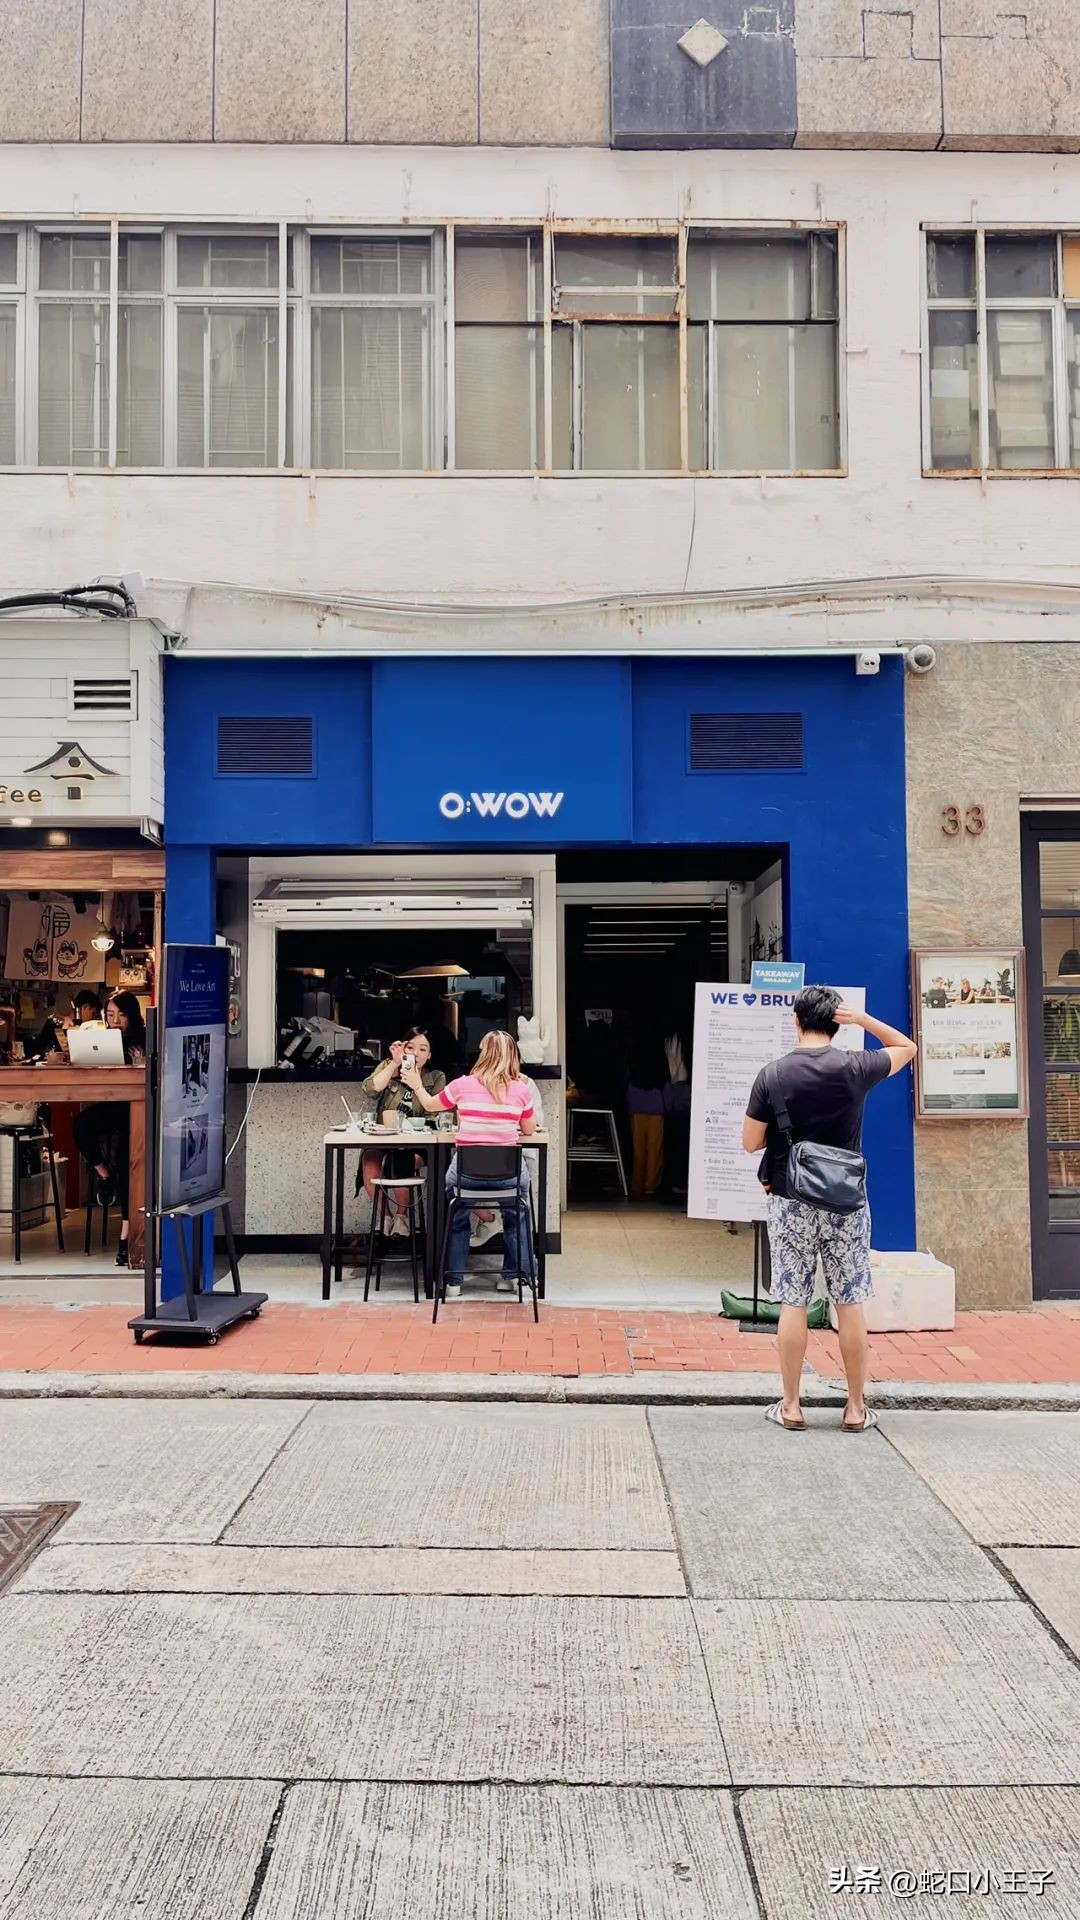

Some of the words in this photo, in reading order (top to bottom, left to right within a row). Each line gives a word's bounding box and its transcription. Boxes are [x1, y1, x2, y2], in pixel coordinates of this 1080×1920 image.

[439, 792, 565, 819] O:WOW
[941, 804, 986, 837] 33
[755, 970, 801, 979] TAKEAWAY
[180, 980, 190, 992] We
[191, 980, 205, 992] Love
[206, 981, 216, 992] Art
[711, 992, 739, 1006] WE
[760, 994, 798, 1007] BRU
